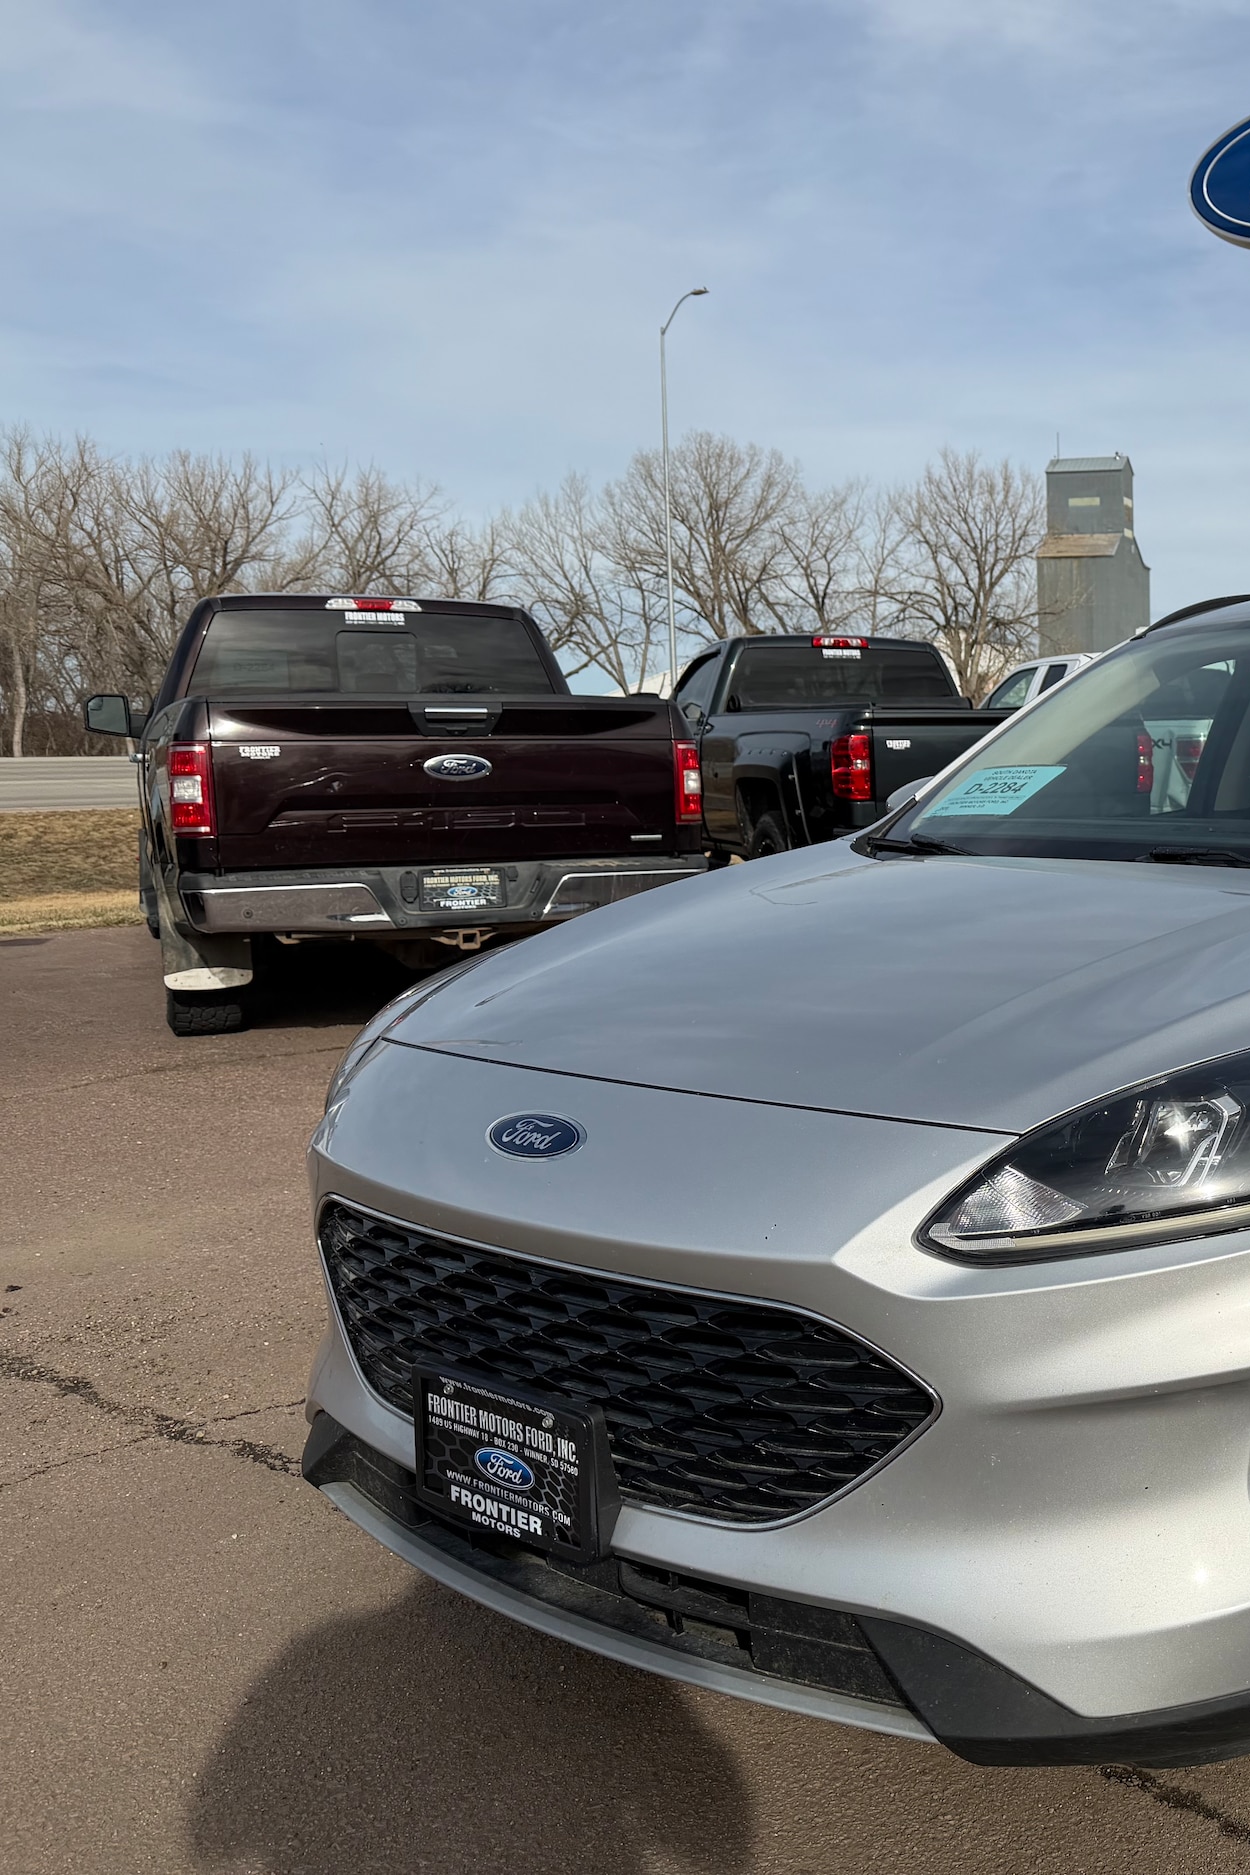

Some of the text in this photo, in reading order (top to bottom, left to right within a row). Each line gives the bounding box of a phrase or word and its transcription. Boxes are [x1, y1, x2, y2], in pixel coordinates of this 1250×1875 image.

[440, 758, 477, 776] Ford
[963, 782, 1028, 795] D-2284
[440, 899, 487, 908] FRONTIER
[501, 1118, 562, 1150] Ford
[427, 1392, 579, 1464] FRONTIER MOTORS FORD, INC.
[444, 1419, 453, 1429] US
[453, 1422, 480, 1439] HIGHWAY
[481, 1431, 489, 1442] 18
[493, 1436, 507, 1449] BOX
[507, 1441, 519, 1453] 230
[550, 1457, 560, 1468] SD
[486, 1453, 523, 1484] Ford
[450, 1484, 543, 1536] FRONTIER
[471, 1510, 522, 1539] MOTORS
